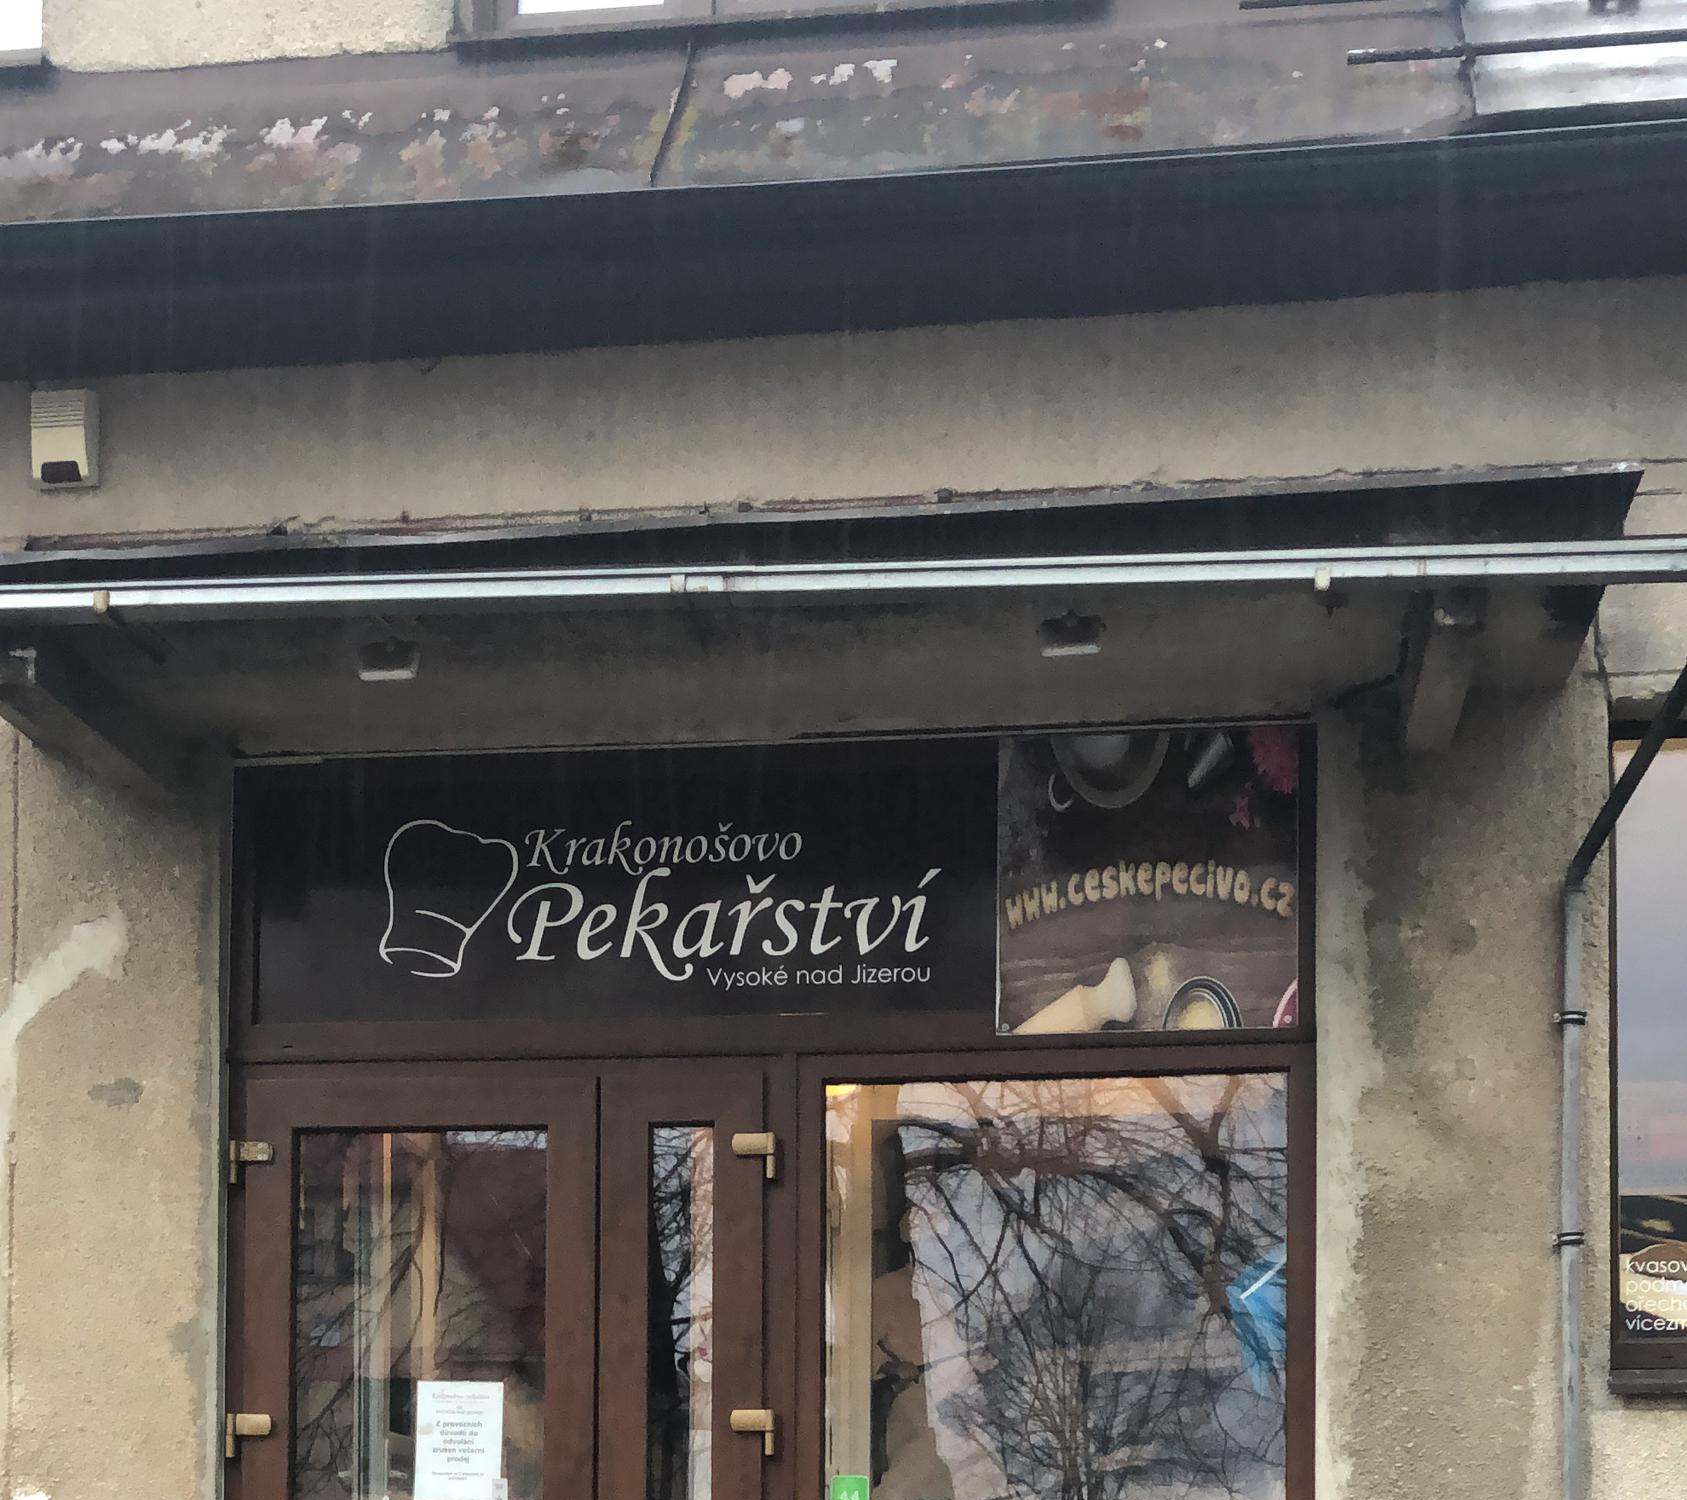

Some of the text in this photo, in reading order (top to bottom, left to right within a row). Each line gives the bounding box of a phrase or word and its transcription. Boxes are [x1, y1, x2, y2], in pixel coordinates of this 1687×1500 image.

[524, 820, 803, 875] Krakonošovo
[507, 867, 942, 981] Pekařství
[1005, 859, 1296, 929] www.ceskepecivo.cz
[706, 964, 931, 991] Vysoké nad Jizerou
